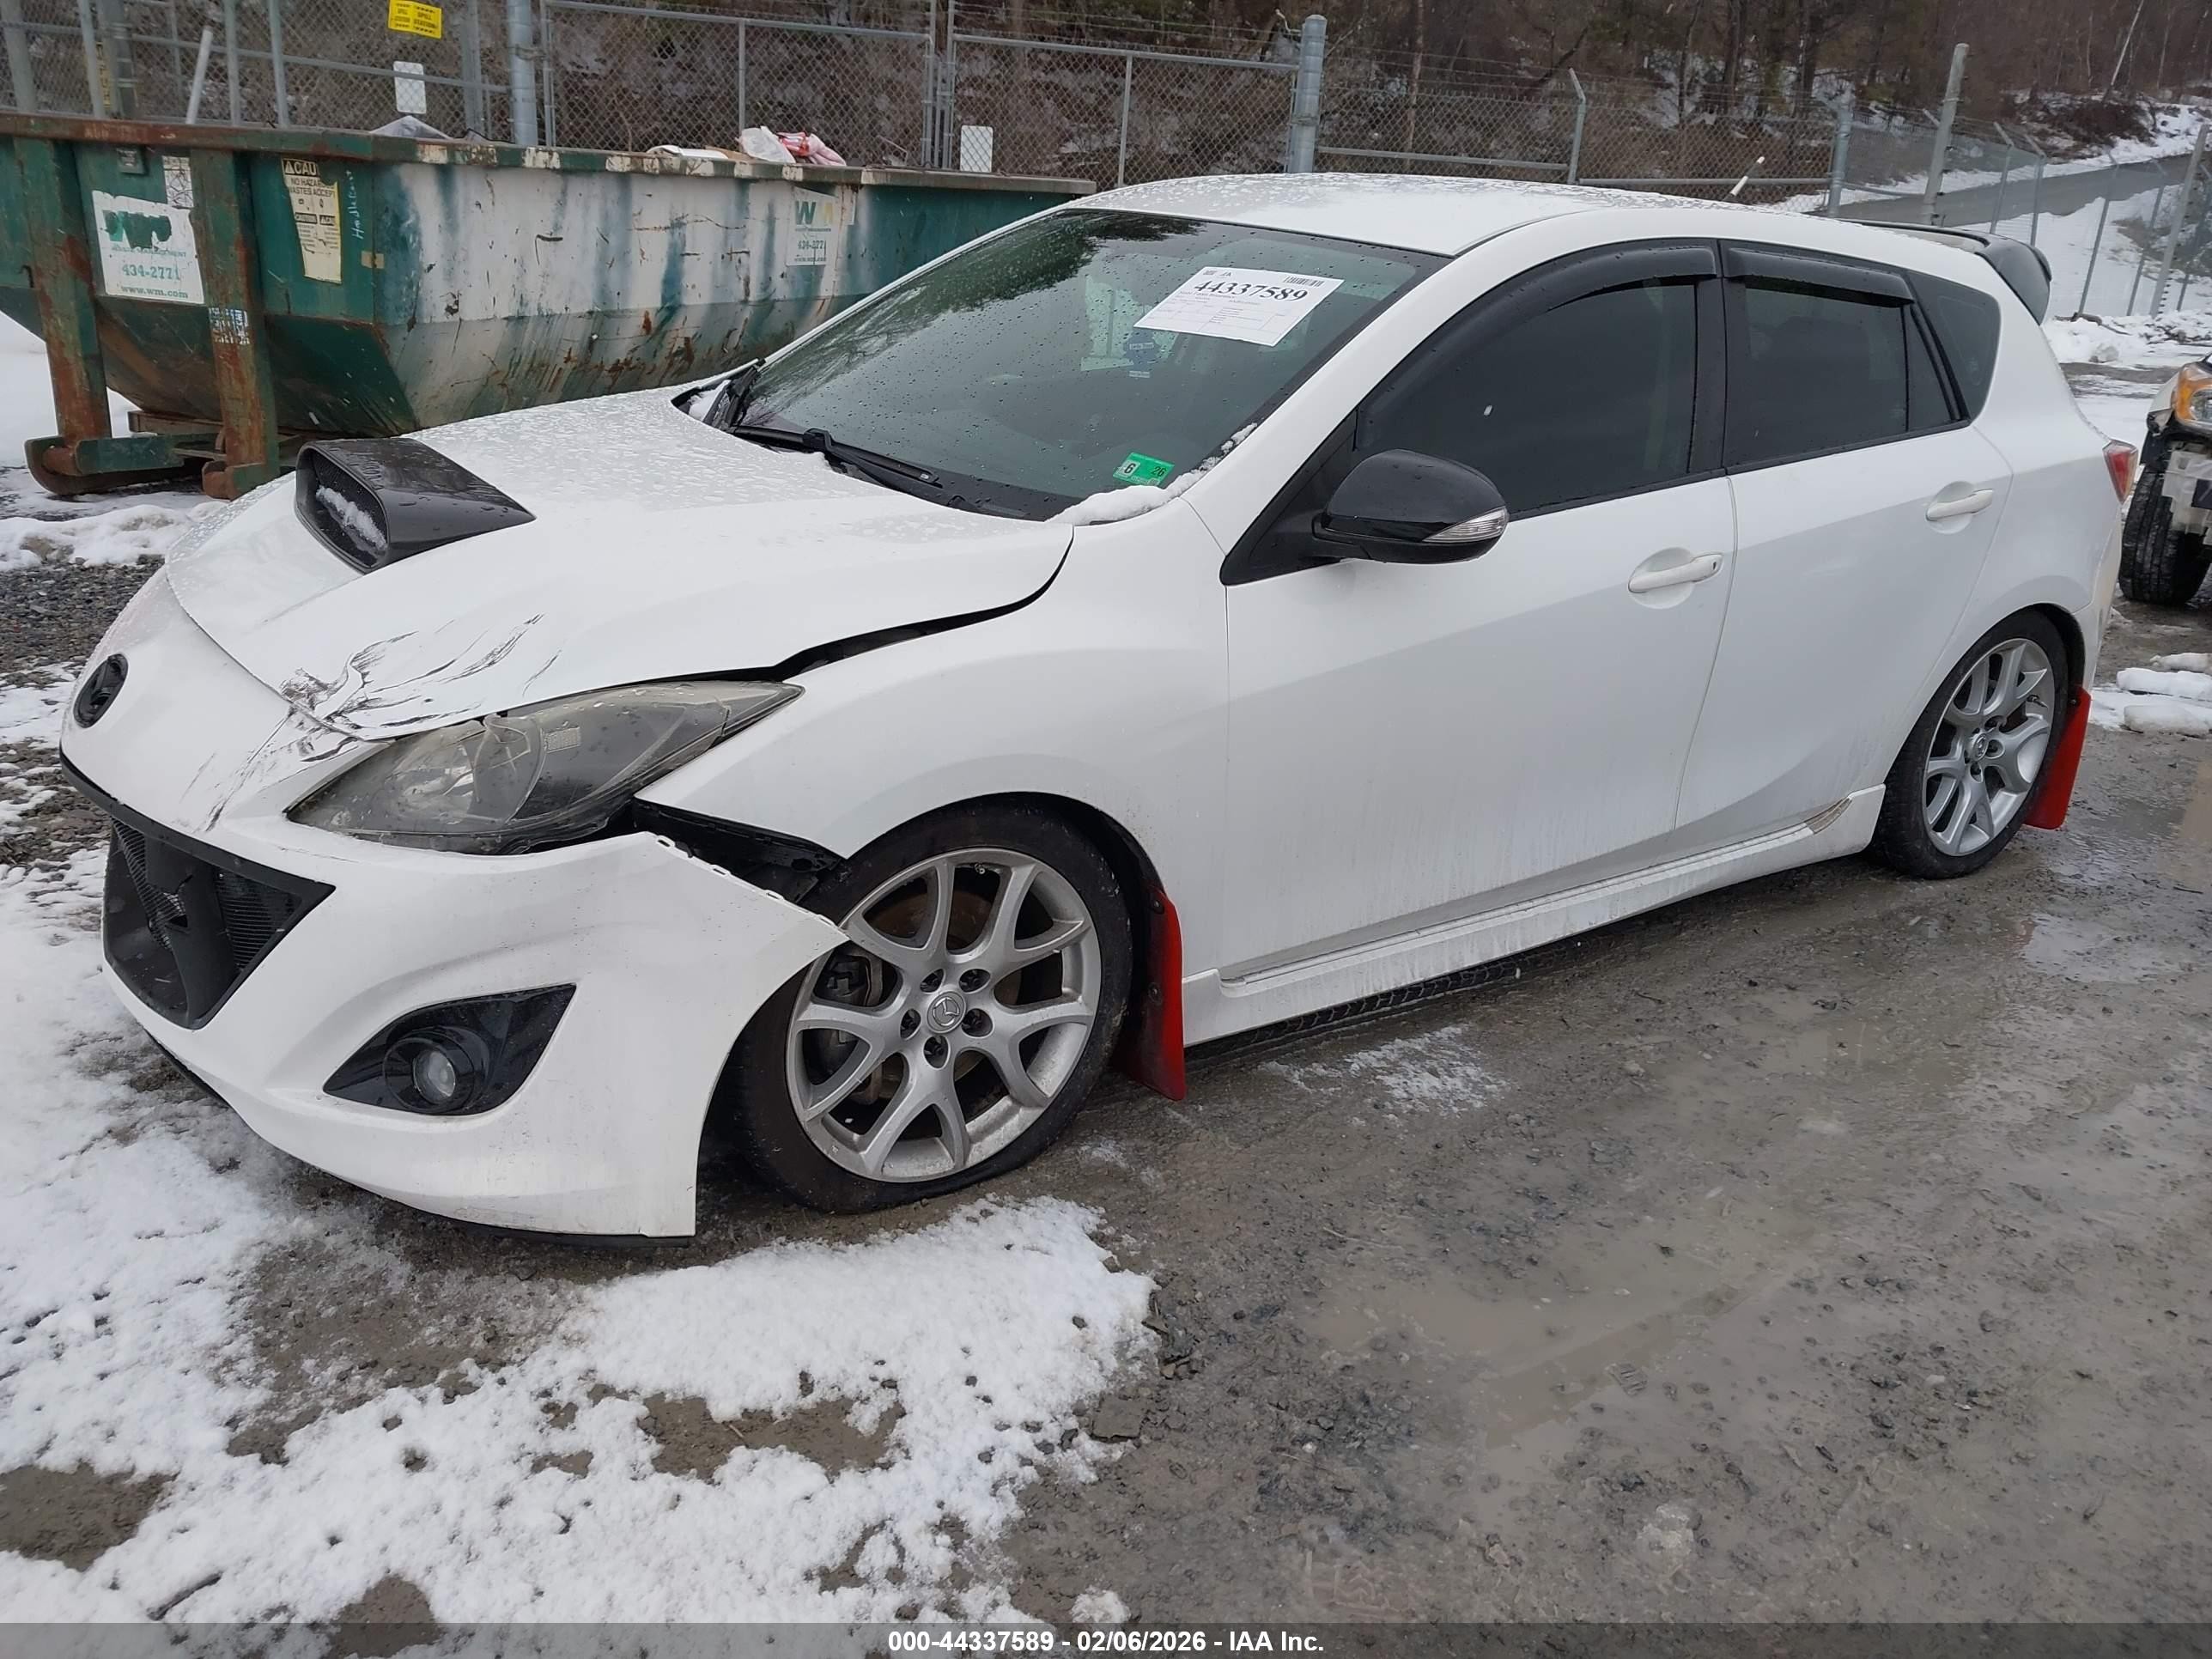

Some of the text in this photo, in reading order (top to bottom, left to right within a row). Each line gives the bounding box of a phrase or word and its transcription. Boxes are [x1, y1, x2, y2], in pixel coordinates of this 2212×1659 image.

[122, 263, 181, 281] 434-2771
[121, 286, 189, 299] www.wm.com
[1194, 280, 1309, 301] 44337589
[1124, 463, 1167, 477] 6 26
